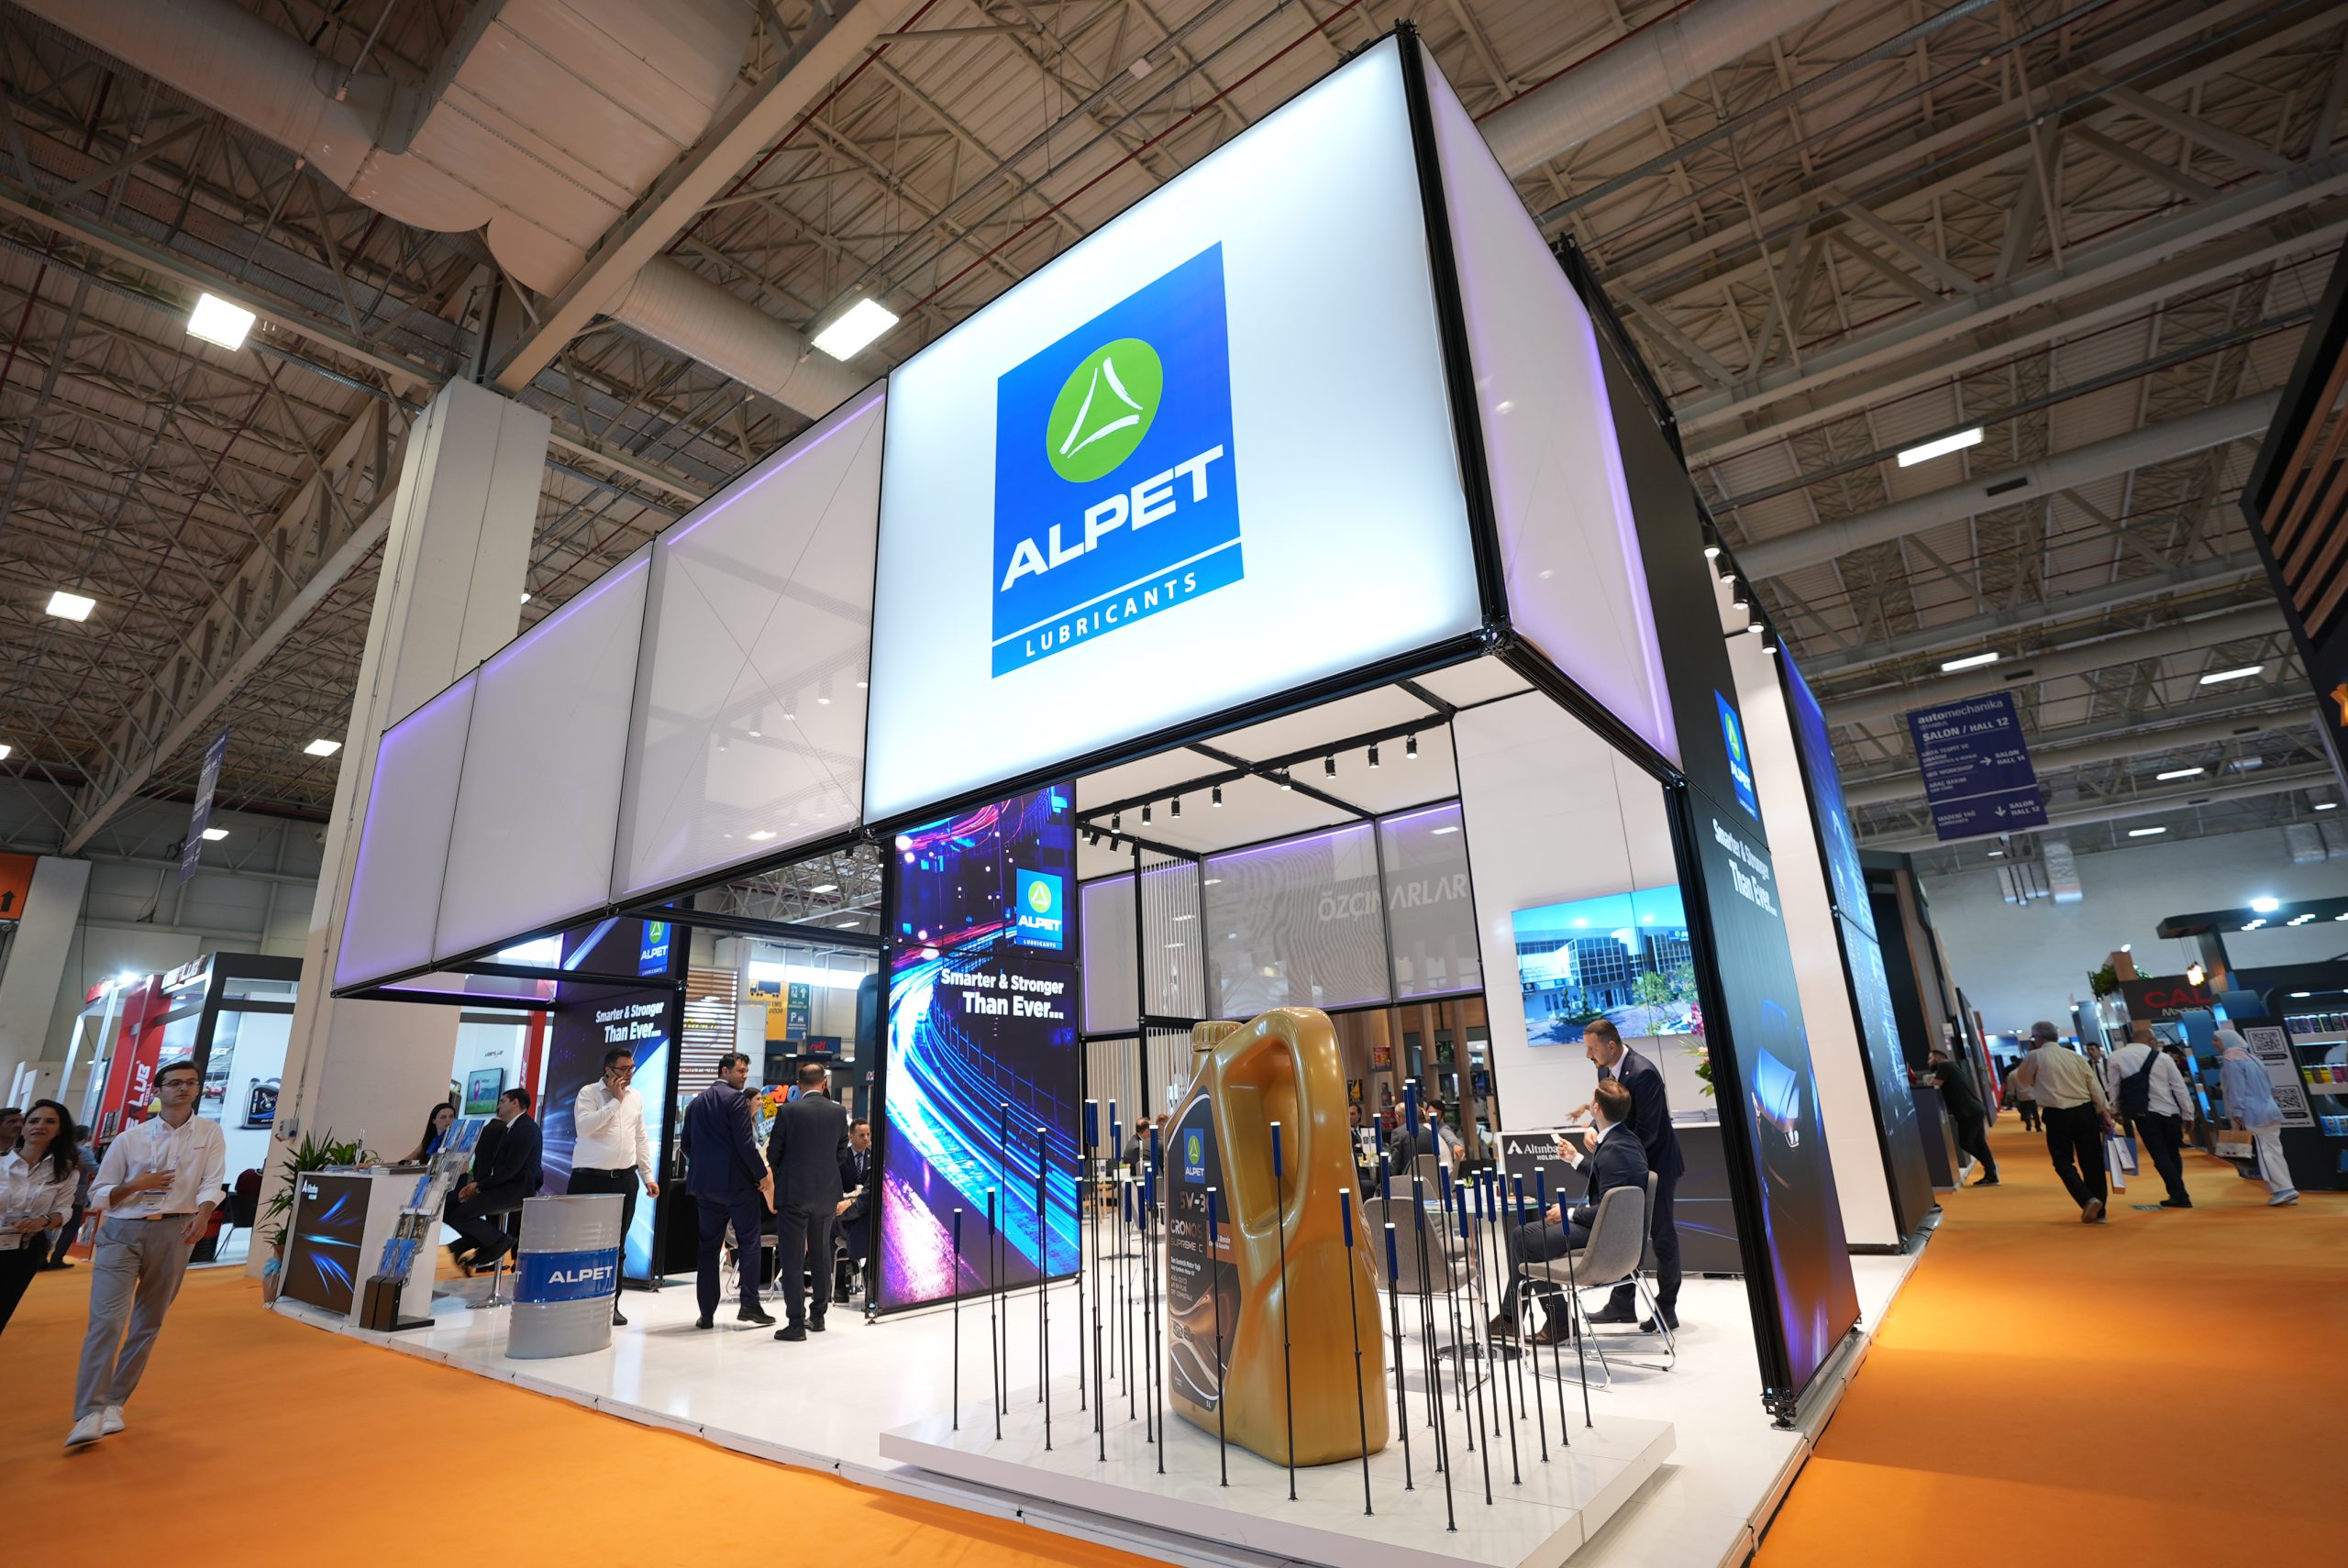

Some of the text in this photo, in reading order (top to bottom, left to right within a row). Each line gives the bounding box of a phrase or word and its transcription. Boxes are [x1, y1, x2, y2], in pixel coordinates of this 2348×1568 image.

[1000, 443, 1224, 592] ALPET
[1025, 571, 1198, 657] LUBRICANTS
[1917, 700, 2004, 724] automechanika
[1922, 717, 2010, 742] SALON / HALL 12
[1995, 749, 2020, 759] SALON
[1997, 756, 2016, 766] HALL
[1939, 764, 1974, 776] WORKSHOP
[2009, 801, 2034, 810] SALON
[2010, 807, 2030, 816] HALL
[1712, 818, 1740, 858] Smarter
[1745, 845, 1770, 880] Stronger
[1728, 858, 1755, 900] Than
[1018, 914, 1062, 932] ALPET
[640, 944, 669, 961] ALPET
[1023, 939, 1057, 949] LUBRICANTS
[941, 968, 1064, 996] Smarter & Stronger
[595, 1001, 665, 1024] Smarter & Stronger
[962, 990, 1064, 1020] Than Ever...
[791, 1011, 797, 1022] P
[604, 1023, 628, 1043] Than
[629, 1021, 662, 1041] Ever...
[1523, 1143, 1558, 1154] Altınba
[1185, 1166, 1205, 1177] ALPET
[1180, 1191, 1210, 1213] 5W-3
[1169, 1218, 1203, 1240] CRONOS
[1169, 1237, 1197, 1252] SUPREME
[548, 1265, 614, 1285] ALPET
